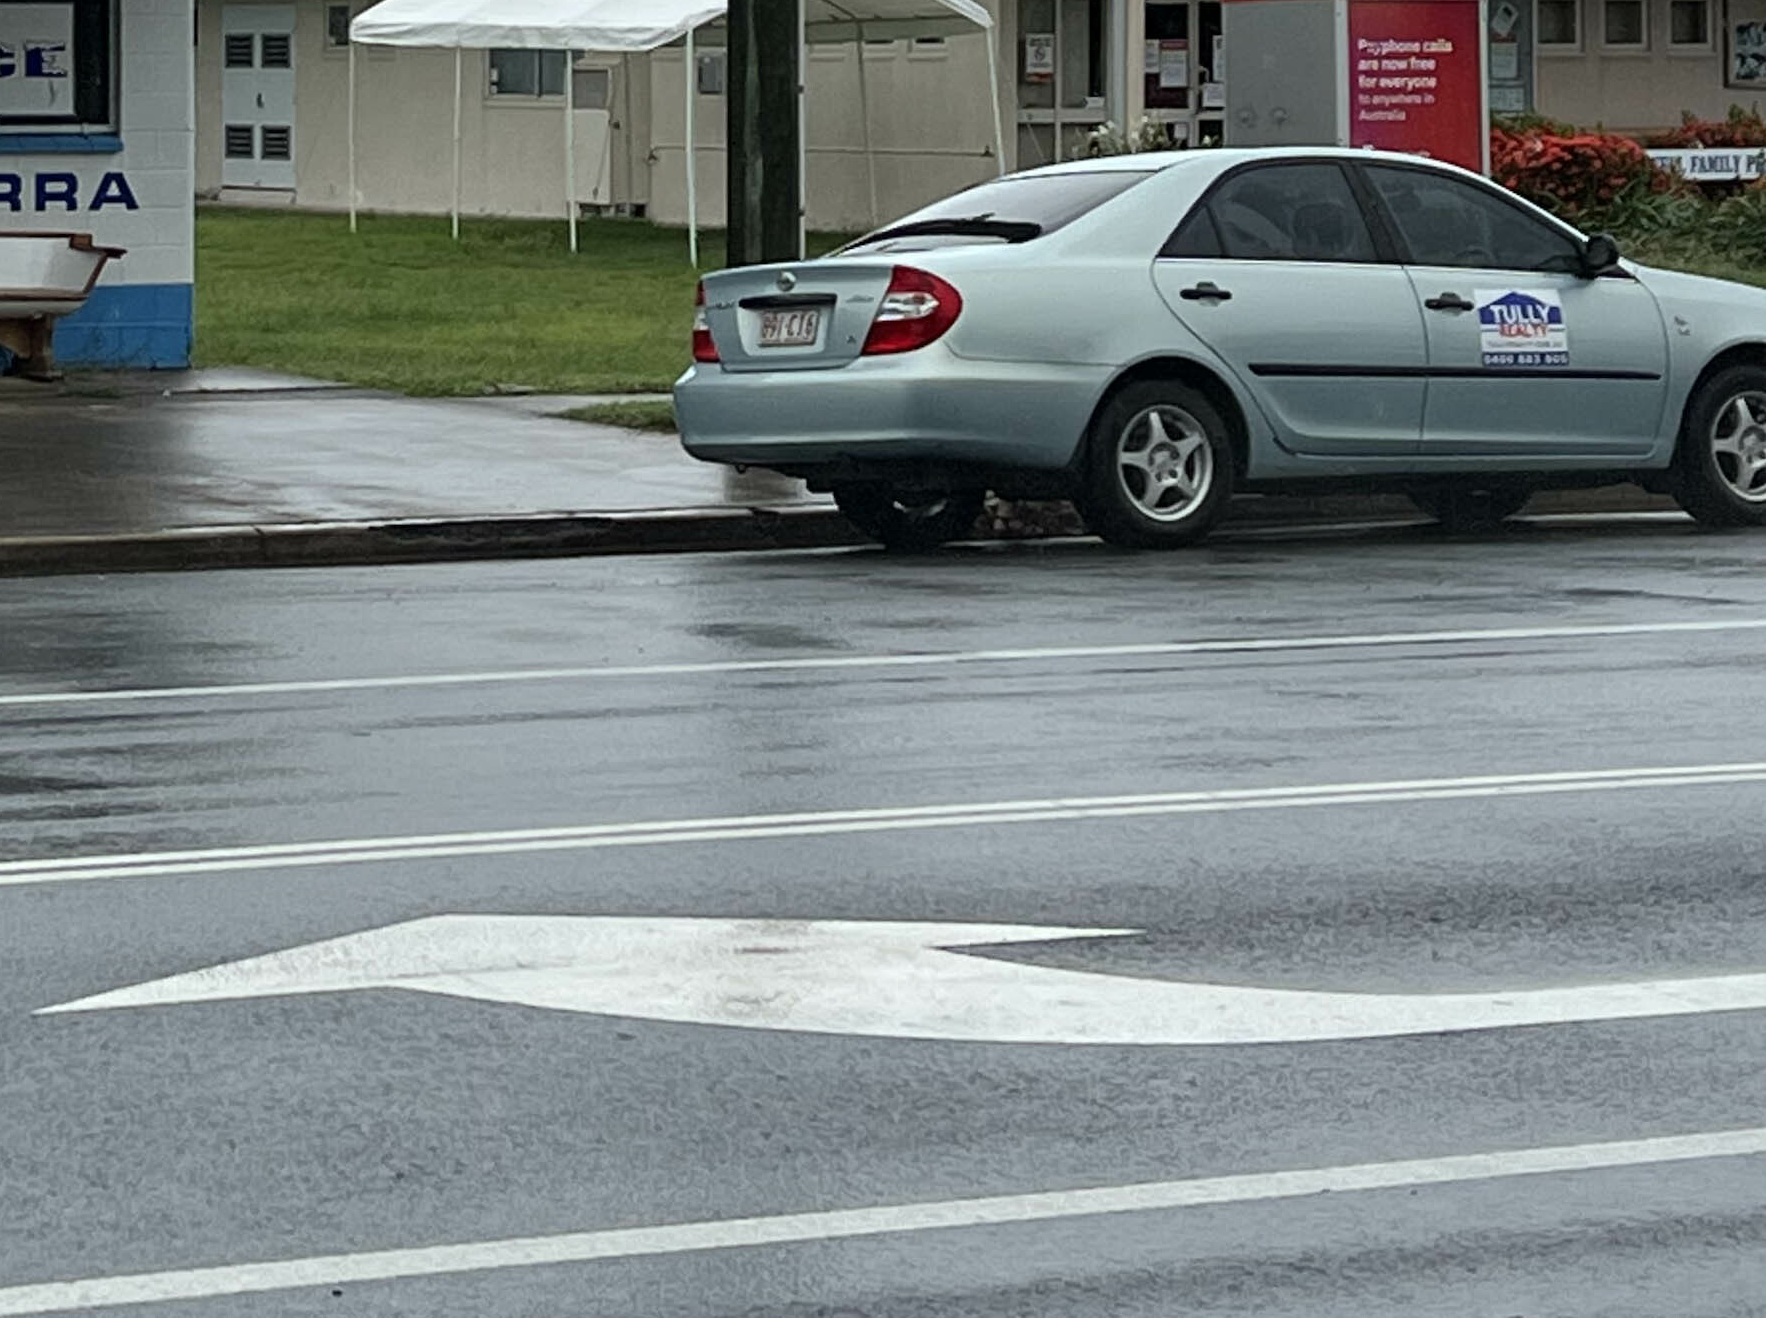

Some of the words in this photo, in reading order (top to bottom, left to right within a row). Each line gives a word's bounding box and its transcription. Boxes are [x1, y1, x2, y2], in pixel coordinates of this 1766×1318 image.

[1358, 75, 1377, 88] for
[1379, 77, 1437, 91] everyone
[1690, 156, 1740, 173] FAMILY
[1489, 303, 1551, 324] TULLY
